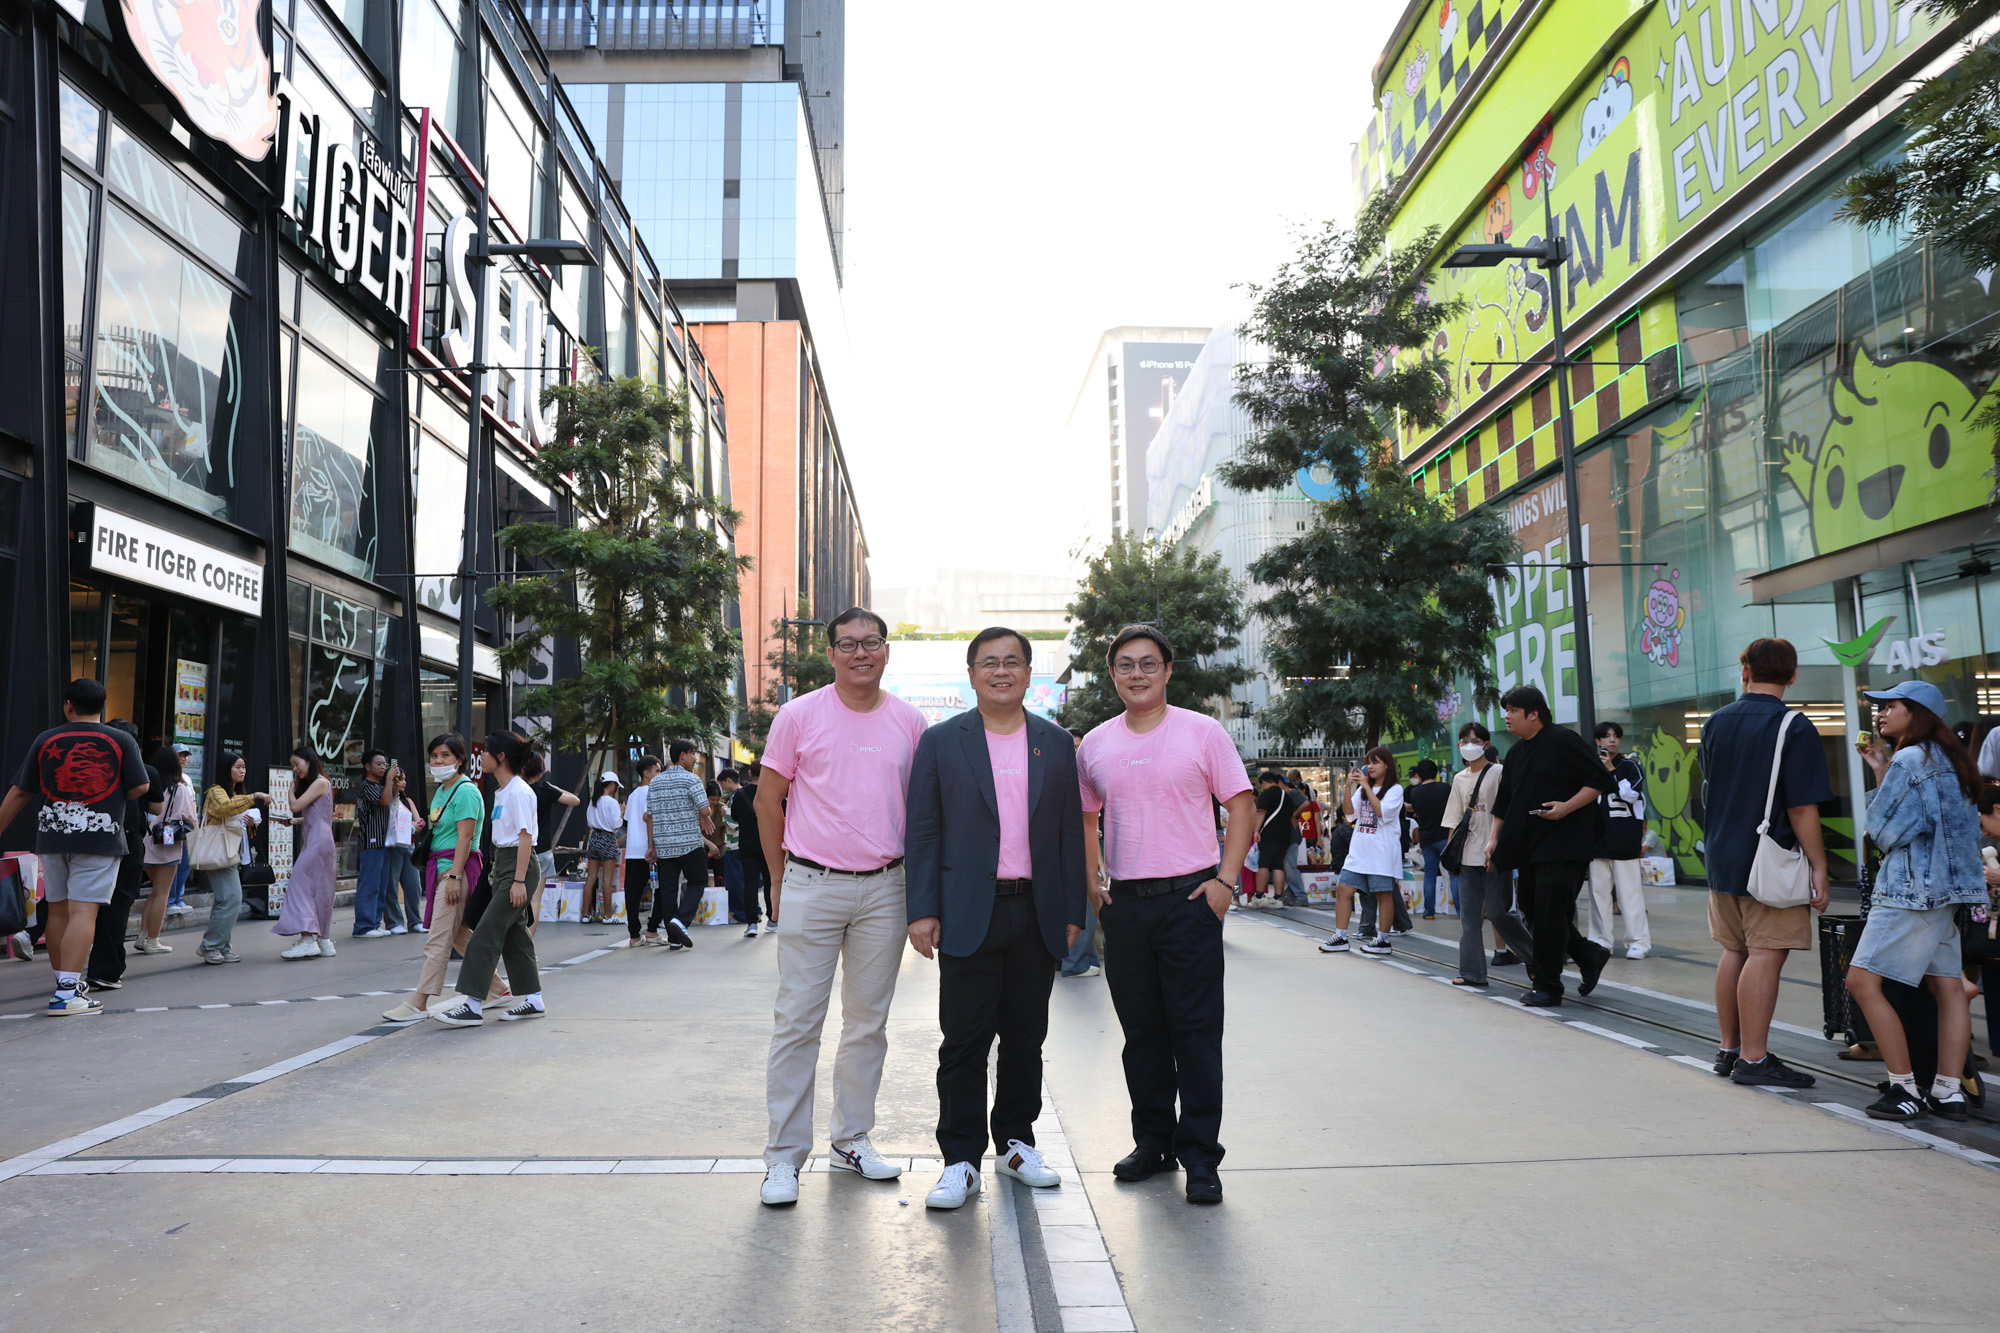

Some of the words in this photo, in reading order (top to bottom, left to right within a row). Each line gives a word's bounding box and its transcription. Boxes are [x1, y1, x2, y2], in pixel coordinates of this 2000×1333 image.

[276, 72, 413, 326] TIGER
[1147, 360, 1174, 369] iPhone
[1174, 361, 1184, 369] 16
[1541, 480, 1568, 517] WIL
[97, 525, 139, 564] FIRE
[145, 542, 197, 583] TIGER
[202, 563, 259, 602] COFFEE
[1886, 631, 1948, 675] AIS
[1130, 758, 1152, 766] PMCU
